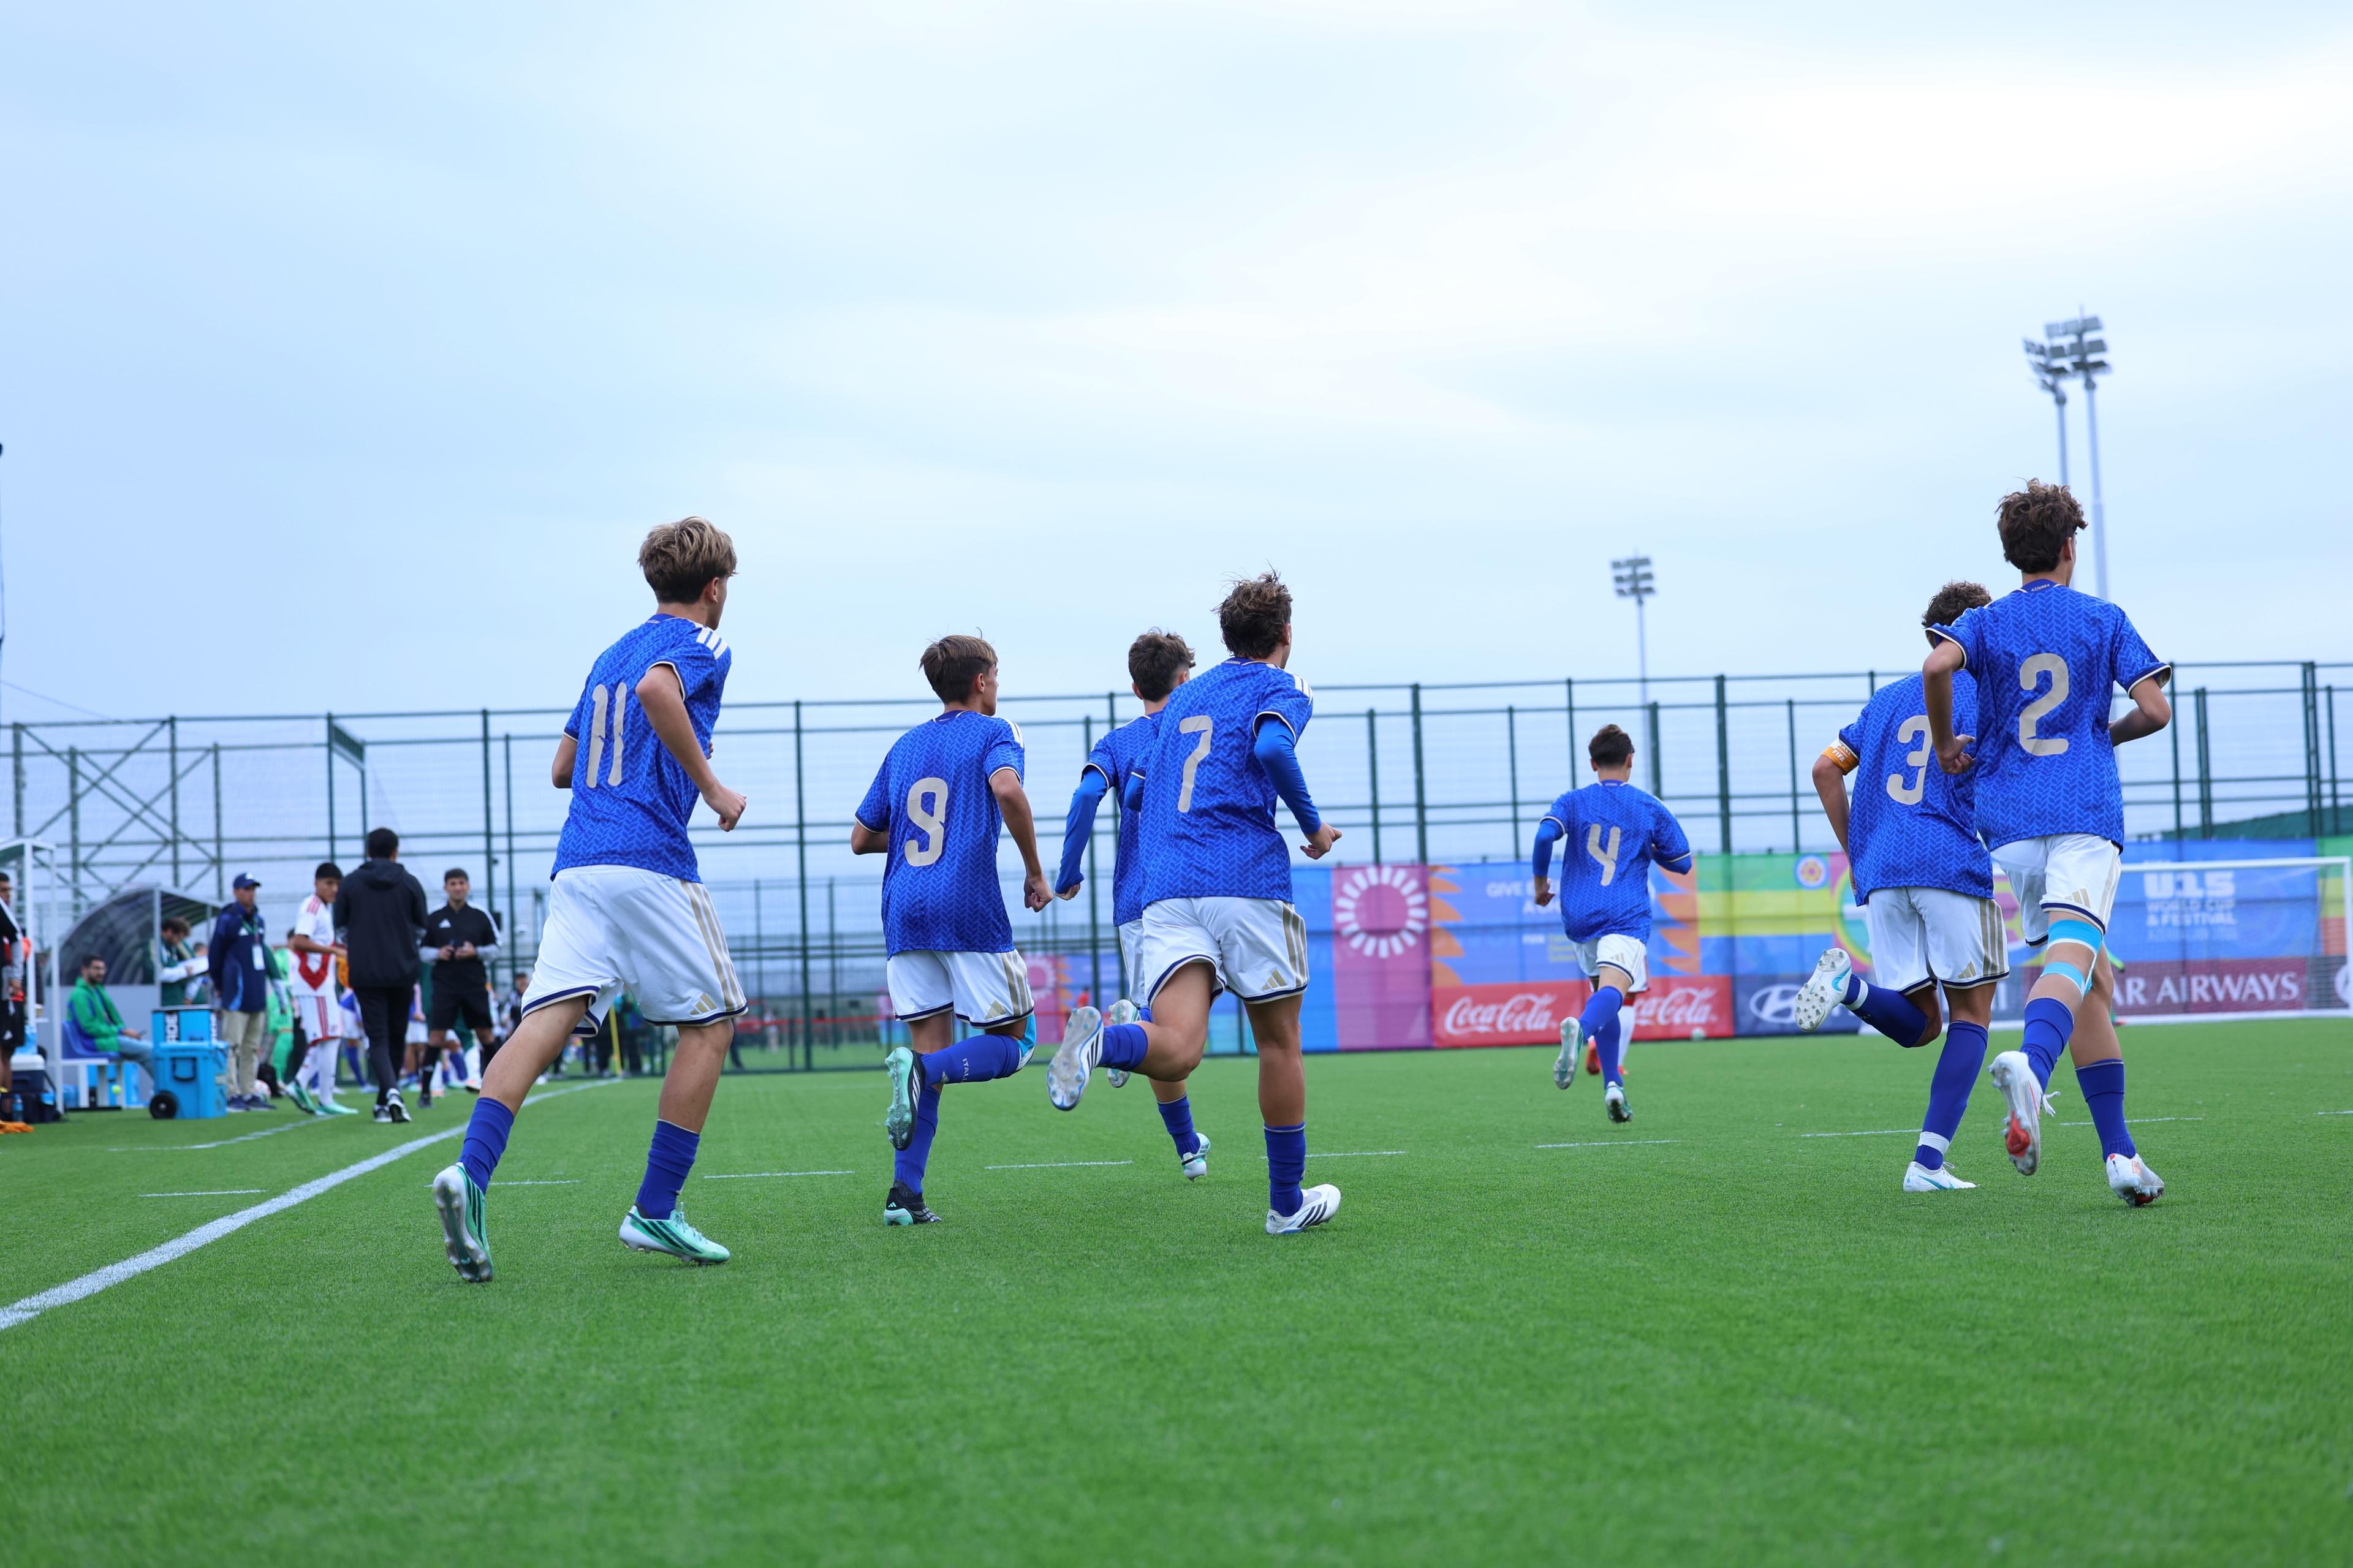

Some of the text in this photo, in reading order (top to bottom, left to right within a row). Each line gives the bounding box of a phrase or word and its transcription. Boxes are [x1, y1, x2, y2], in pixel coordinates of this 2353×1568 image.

[2018, 653, 2069, 757] 2
[586, 682, 627, 789] 11
[1832, 749, 1844, 762] FIFA
[1178, 715, 1213, 814] 7
[1886, 714, 1933, 806] 3
[904, 777, 949, 868] 9
[1587, 823, 1621, 887] 4
[1486, 881, 1523, 898] GIVE
[2143, 870, 2235, 899] U15
[2146, 898, 2236, 912] WORLD CUP
[2161, 911, 2238, 926] FESTIVAL
[2156, 971, 2300, 1005] AIRWAYS
[1444, 993, 1558, 1036] Coca-Cola
